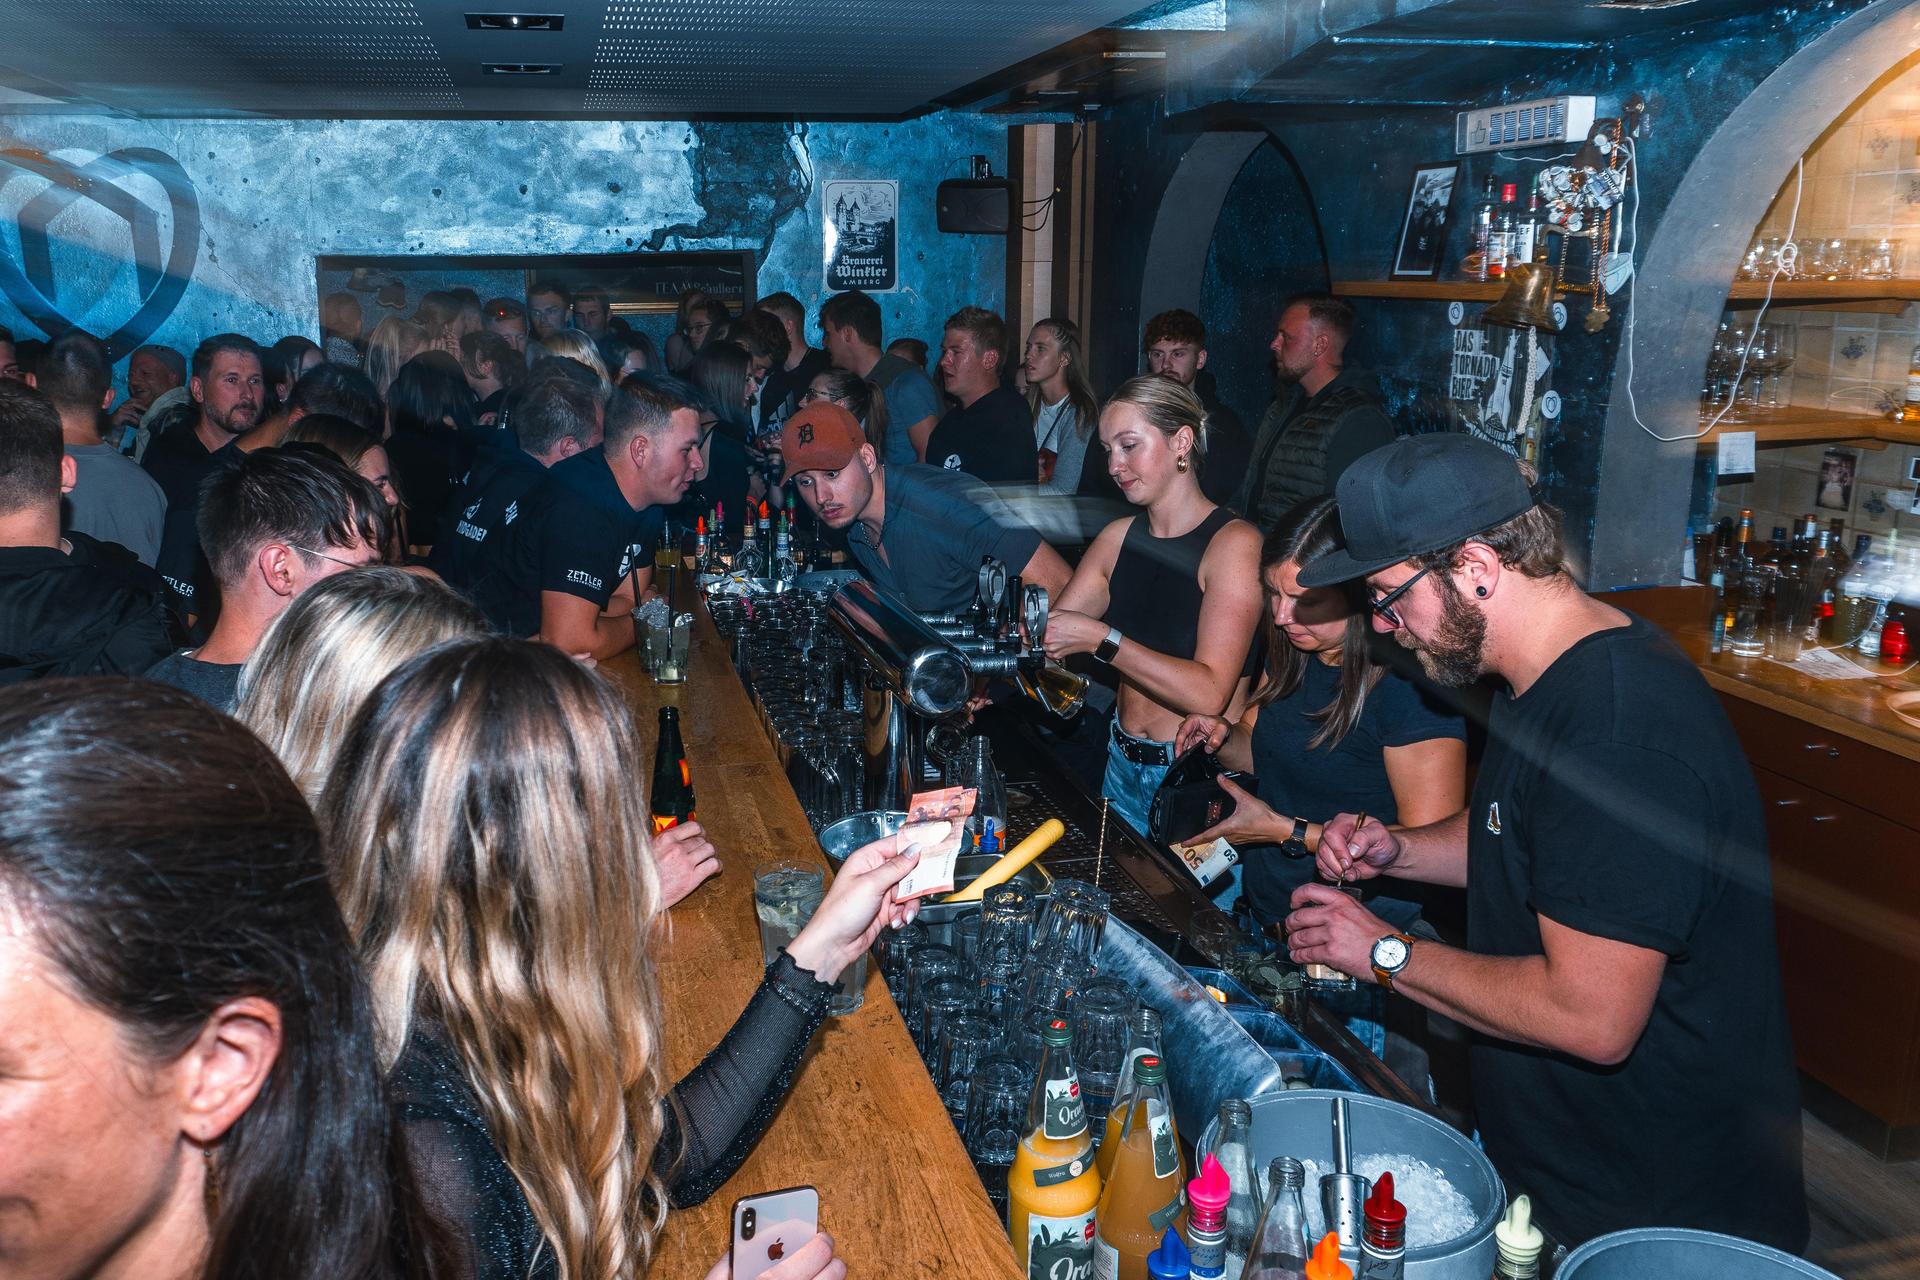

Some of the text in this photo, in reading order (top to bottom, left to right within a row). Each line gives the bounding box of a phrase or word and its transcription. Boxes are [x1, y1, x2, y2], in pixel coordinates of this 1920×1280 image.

[841, 255, 884, 265] Brauerei
[836, 265, 888, 278] Winkler
[1455, 330, 1474, 352] DAS
[1454, 353, 1497, 379] TORNADO
[1452, 376, 1472, 399] BIER
[566, 569, 604, 588] ZETTLER
